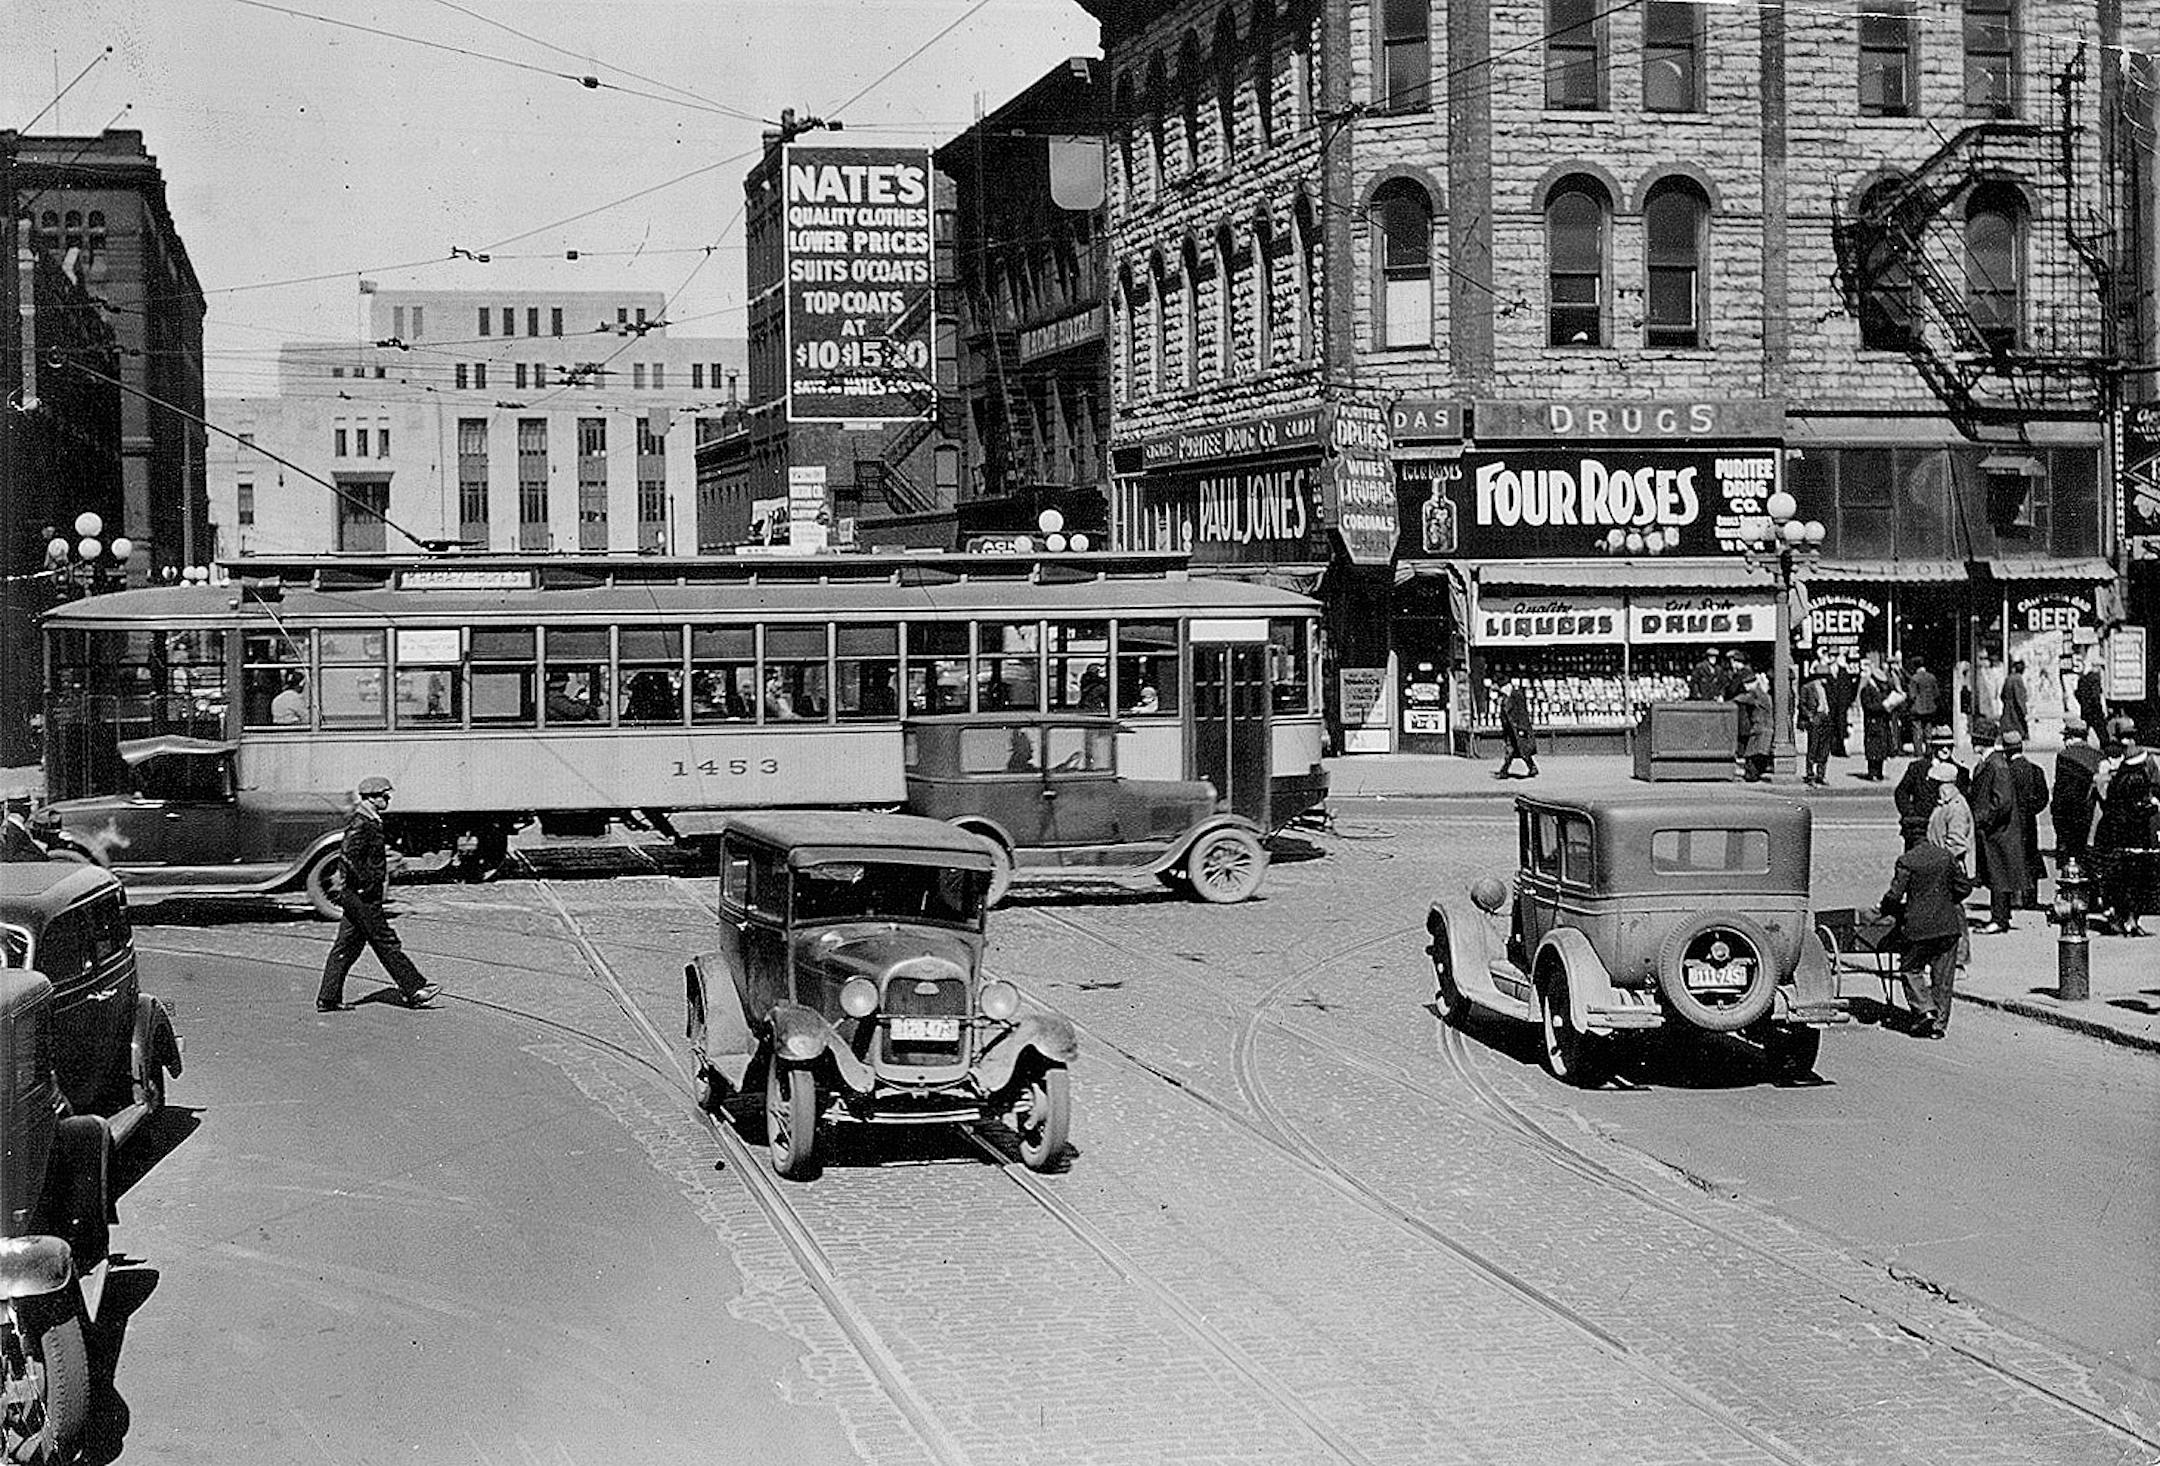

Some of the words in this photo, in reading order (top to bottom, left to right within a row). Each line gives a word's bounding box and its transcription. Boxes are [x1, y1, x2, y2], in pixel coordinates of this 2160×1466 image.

[789, 164, 925, 204] NATE'S
[789, 207, 856, 227] QUALITY
[857, 207, 928, 227] CLOTHES
[789, 231, 848, 254] LOWER
[853, 231, 929, 254] PRICES
[791, 259, 849, 282] SUITS
[851, 259, 928, 282] O'COATS
[841, 319, 866, 336] AT
[796, 340, 840, 369] $10
[842, 340, 883, 368] $15
[1394, 410, 1450, 428] DAS
[1550, 404, 1714, 434] DRUGS
[1225, 426, 1256, 452] DRUG
[1337, 419, 1389, 450] DRUGS
[1346, 459, 1385, 478] WINES
[1715, 458, 1774, 480] PURITEE
[1338, 479, 1396, 506] LIQUORS
[1475, 460, 1578, 526] FOUR
[1581, 459, 1700, 526] ROSES
[1722, 479, 1768, 498] DRUG
[1200, 476, 1245, 543] PAUL
[1241, 468, 1306, 545] JONES
[1729, 497, 1762, 514] CO.
[1342, 514, 1396, 532] CORDIALS
[1513, 602, 1573, 615] Quality
[2028, 607, 2080, 632] BEER
[1486, 614, 1613, 638] LIQUORS
[1641, 613, 1753, 634] DRUGS
[1812, 609, 1865, 634] BEER
[1816, 645, 1860, 659] CFE
[672, 759, 779, 777] 1453
